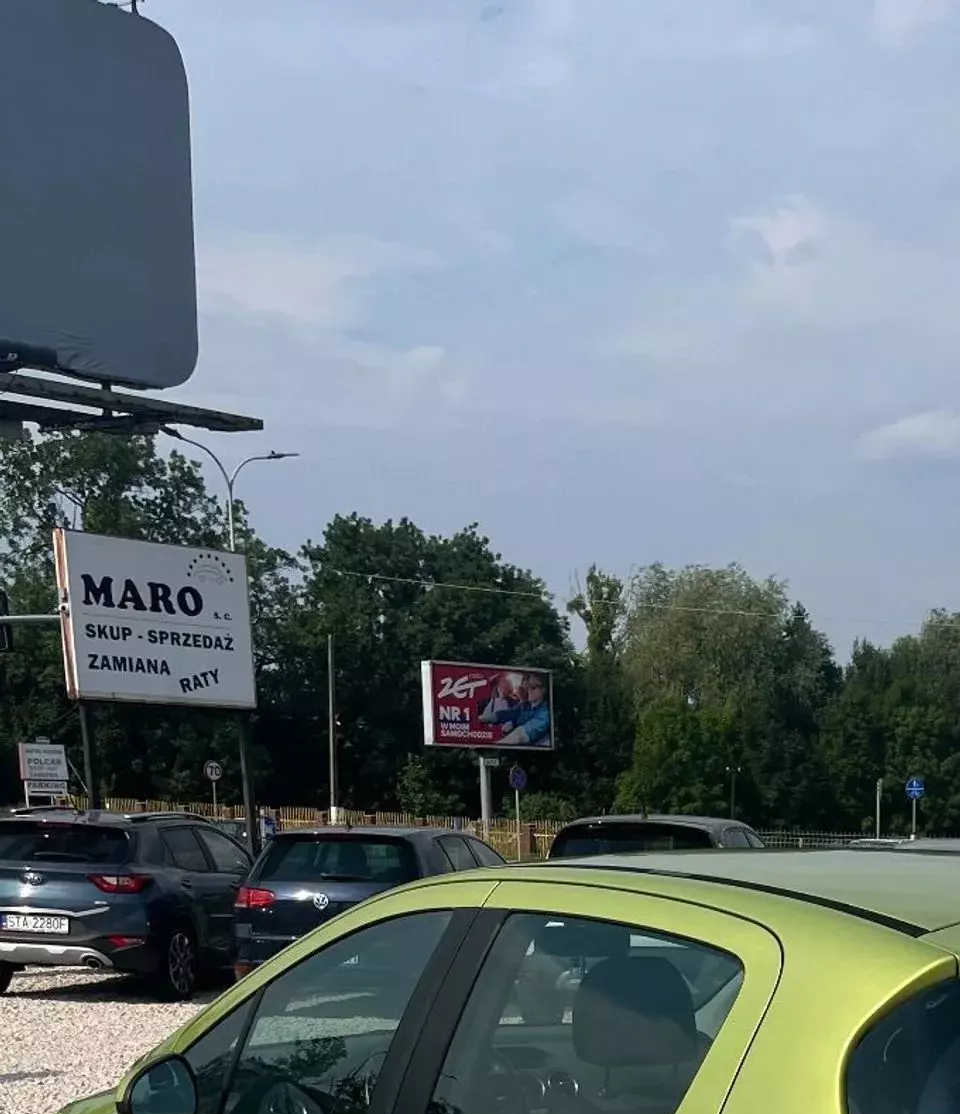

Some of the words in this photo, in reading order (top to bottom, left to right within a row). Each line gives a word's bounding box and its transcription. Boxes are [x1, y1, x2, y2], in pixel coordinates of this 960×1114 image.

[81, 574, 203, 616] MARO
[85, 623, 132, 641] SKUP
[147, 630, 235, 651] SPRZEDAŻ
[88, 654, 171, 676] ZAMIANA
[179, 668, 220, 694] RATY
[440, 706, 461, 721] NR
[463, 707, 470, 721] 1
[8, 916, 28, 928] STA
[32, 916, 66, 930] 2280F
